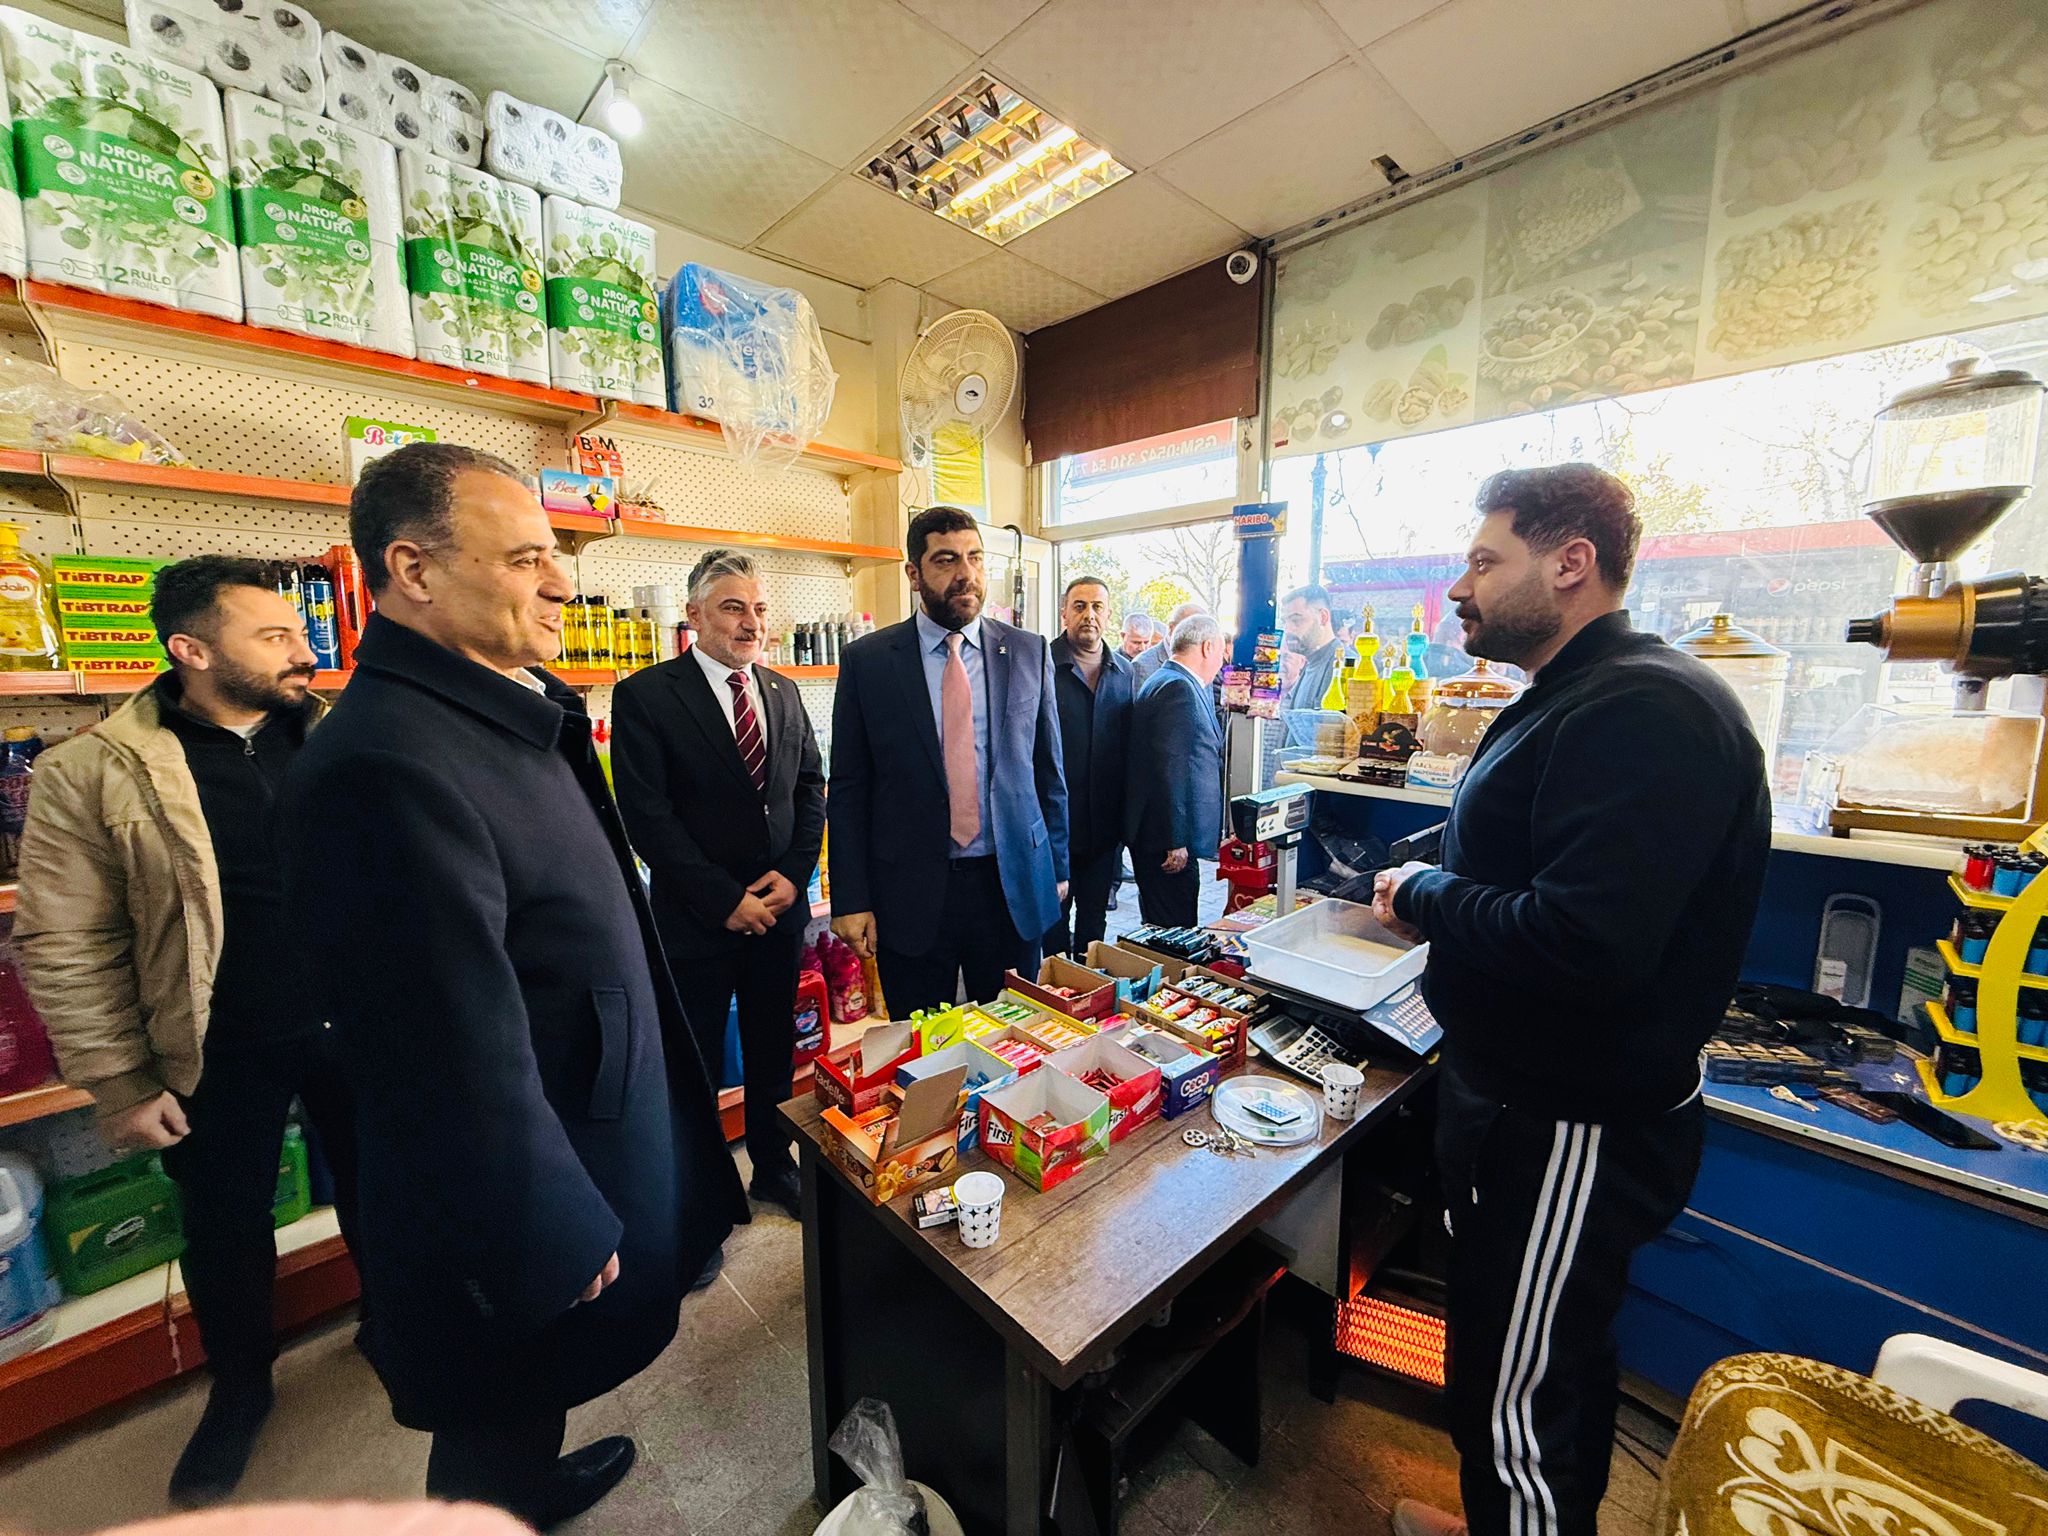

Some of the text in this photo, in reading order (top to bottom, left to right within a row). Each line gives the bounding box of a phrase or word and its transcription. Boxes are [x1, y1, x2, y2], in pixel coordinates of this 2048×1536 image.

[100, 141, 153, 165] DROP
[79, 150, 178, 190] NATURA
[302, 202, 338, 220] DROP
[288, 209, 355, 236] NATURA
[469, 251, 504, 268] DROP
[98, 262, 172, 286] 12 RULO
[456, 259, 519, 287] NATURA
[602, 287, 628, 302] DROP
[590, 295, 640, 319] NATURA
[305, 308, 332, 327] 12
[463, 348, 485, 364] 12
[598, 376, 617, 390] 12
[1233, 513, 1269, 526] HARIBO
[1793, 578, 1846, 595] pepsi
[986, 1120, 1014, 1144] First
